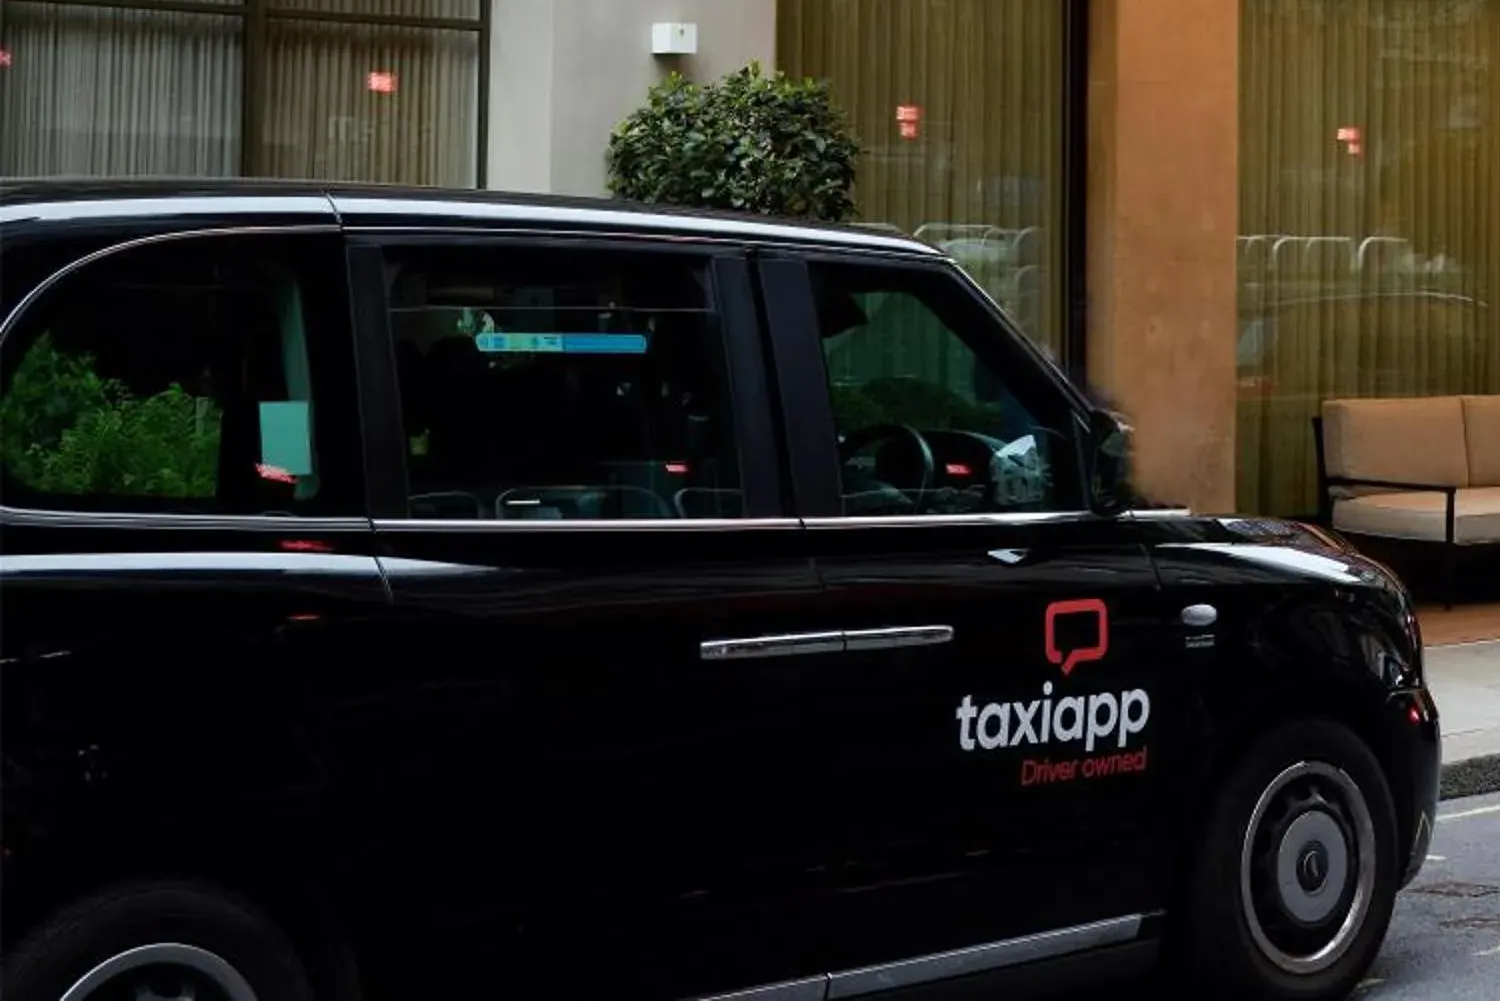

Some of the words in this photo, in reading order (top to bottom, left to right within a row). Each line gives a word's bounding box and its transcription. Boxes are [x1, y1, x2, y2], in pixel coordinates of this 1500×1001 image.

[956, 680, 1150, 752] taxiapp
[1020, 756, 1079, 787] Driver
[1081, 744, 1147, 778] owned
